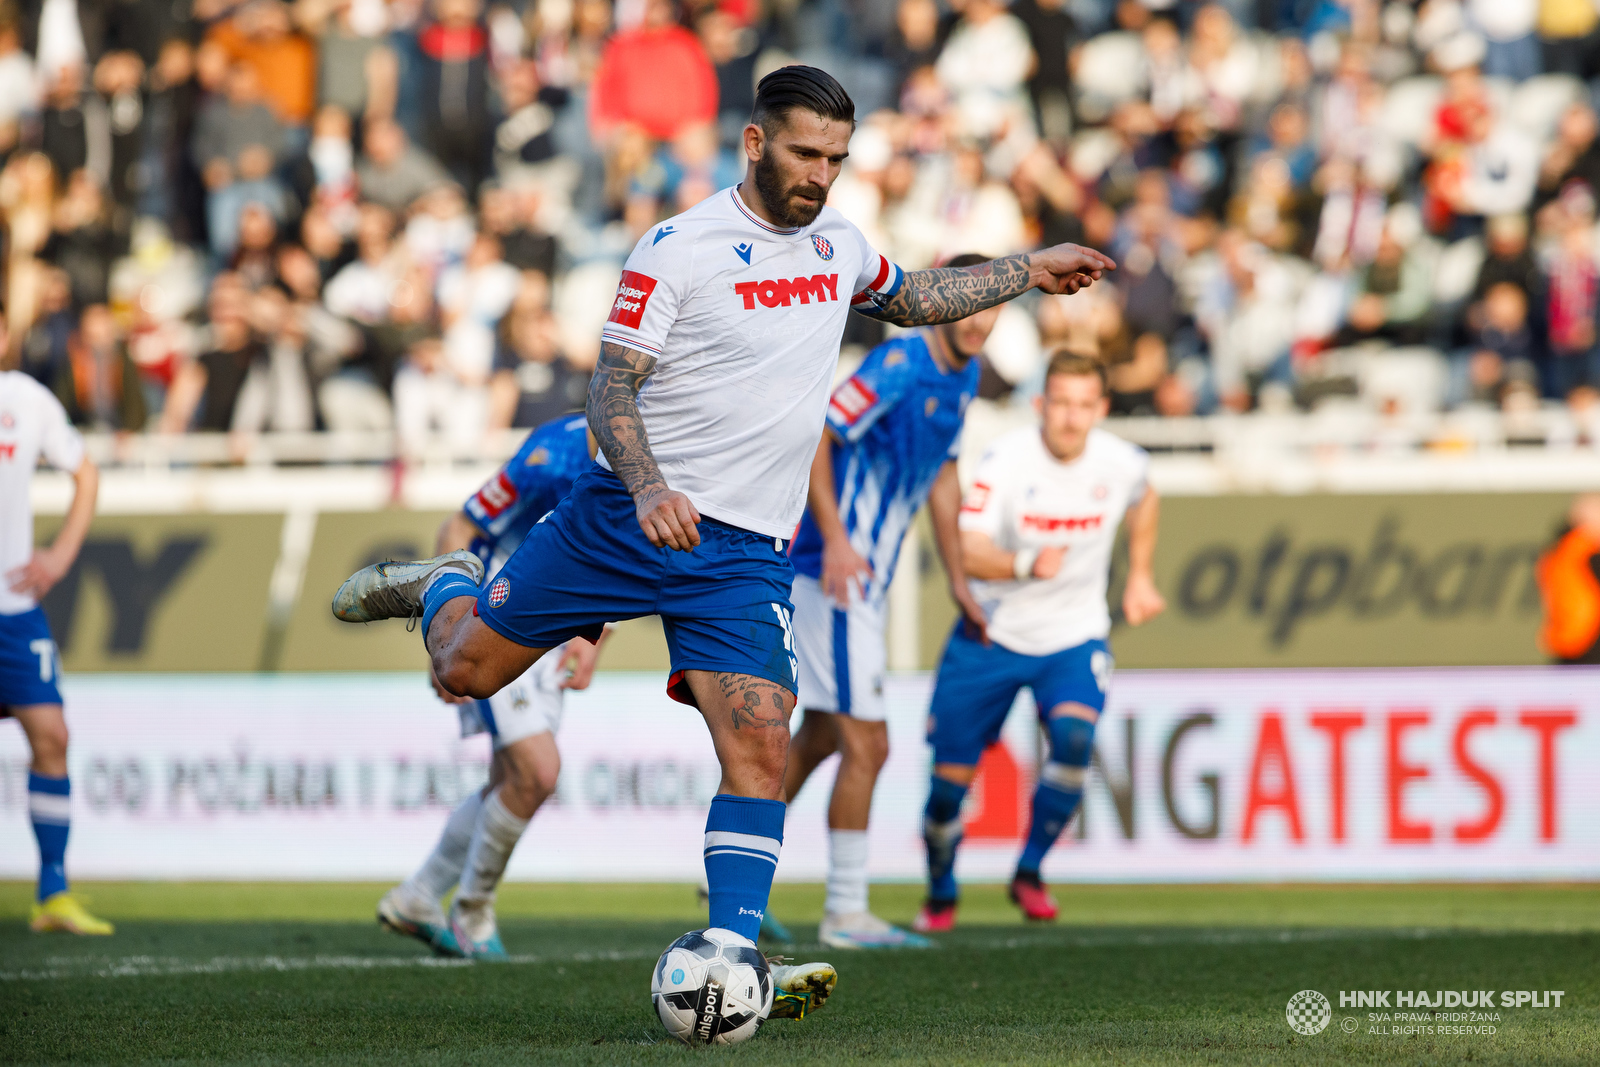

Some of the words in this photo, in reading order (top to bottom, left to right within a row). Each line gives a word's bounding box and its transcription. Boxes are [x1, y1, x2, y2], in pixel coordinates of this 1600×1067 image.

[614, 296, 641, 313] Sport
[618, 282, 647, 299] Super
[735, 274, 838, 310] TOMMY
[1177, 511, 1540, 651] otpban
[698, 982, 720, 1040] uhlsport
